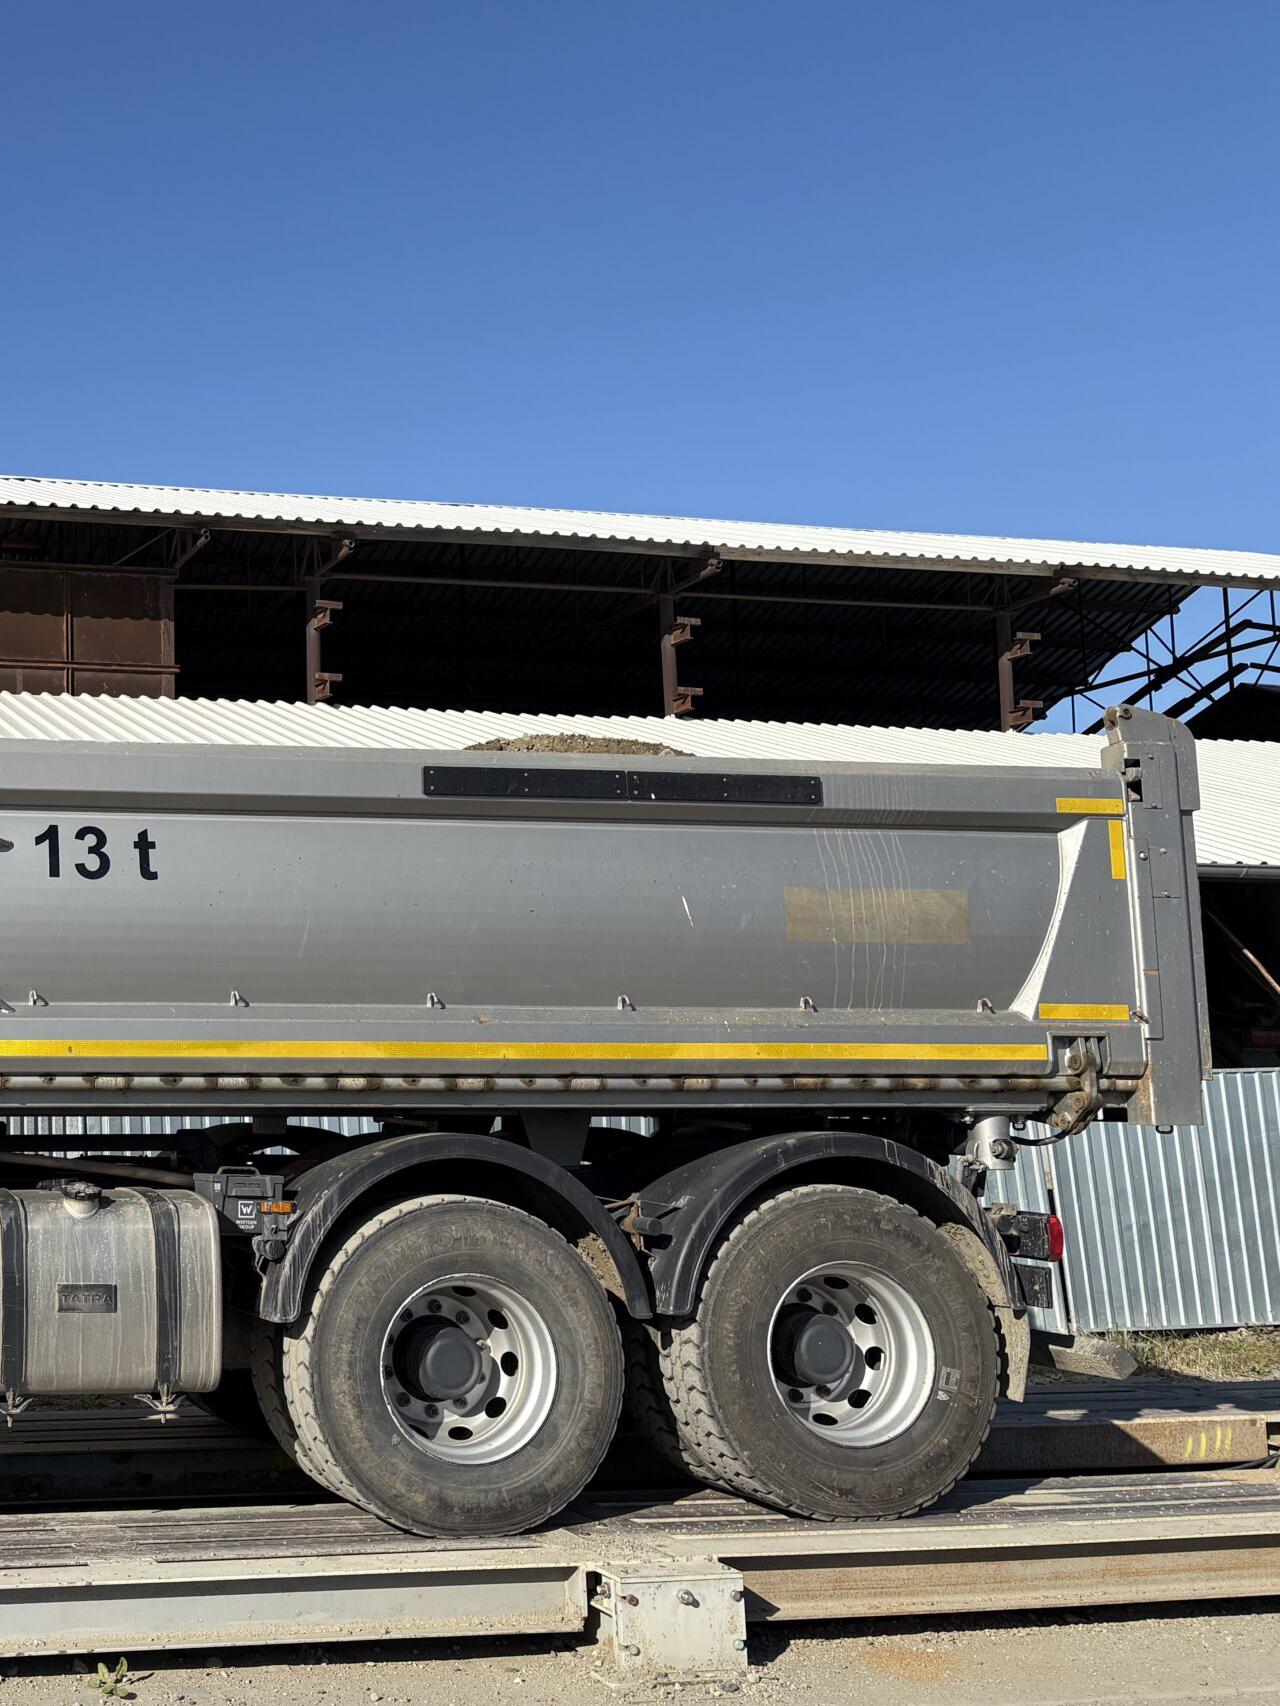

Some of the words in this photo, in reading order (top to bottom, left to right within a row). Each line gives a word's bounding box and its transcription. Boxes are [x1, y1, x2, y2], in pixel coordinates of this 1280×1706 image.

[34, 824, 111, 880] 13
[133, 828, 159, 881] t
[61, 1294, 113, 1305] TATRA
